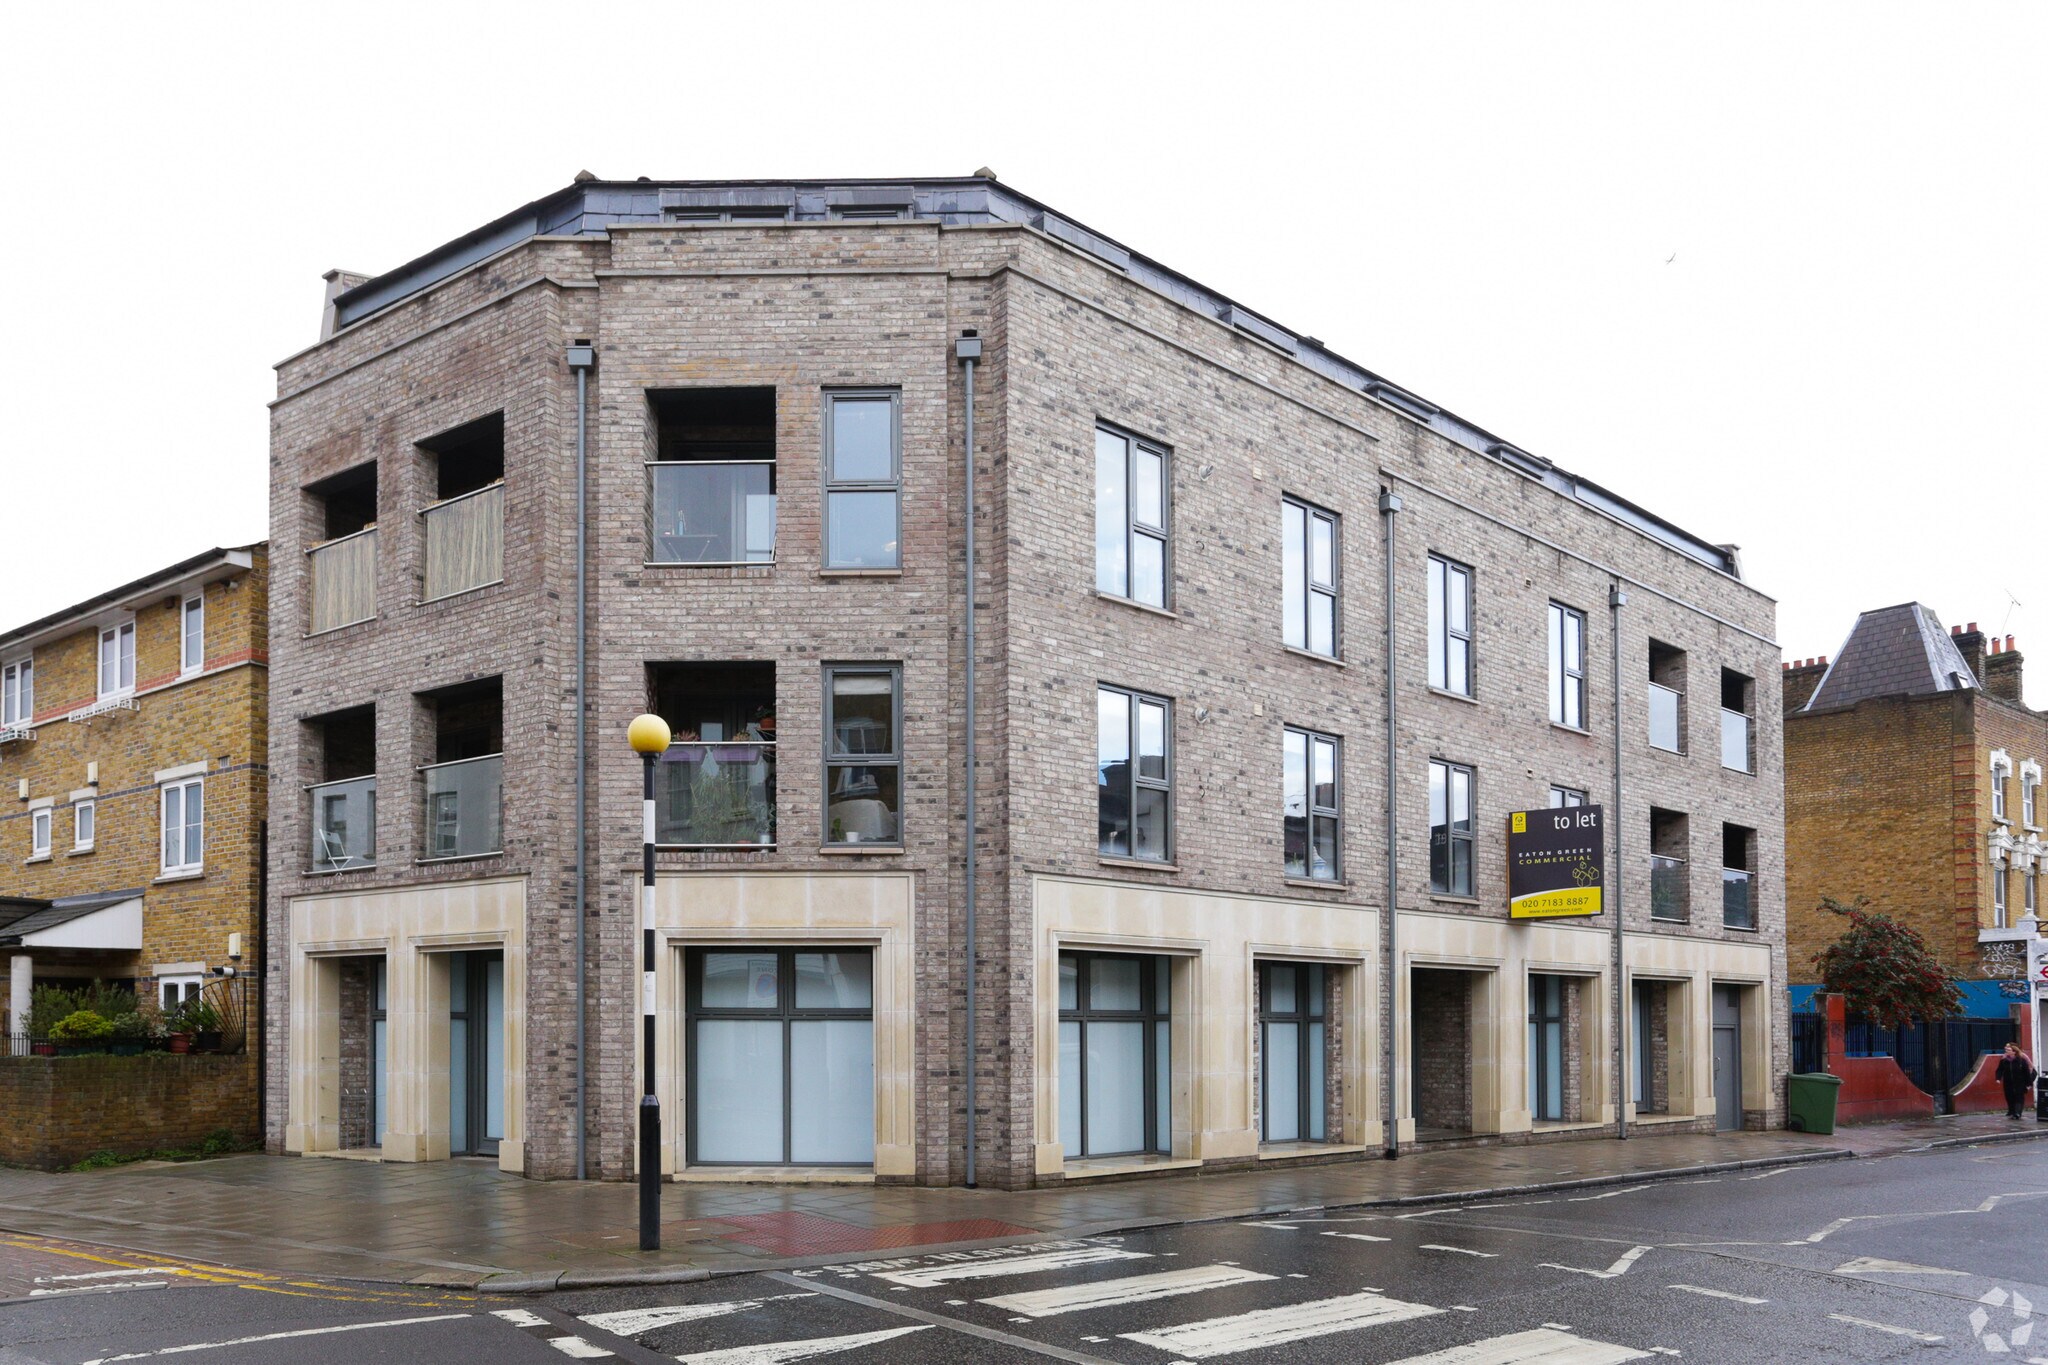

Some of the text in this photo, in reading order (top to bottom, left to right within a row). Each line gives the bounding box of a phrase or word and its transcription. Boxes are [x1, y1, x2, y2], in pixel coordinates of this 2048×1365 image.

[1554, 811, 1597, 830] to let
[1519, 848, 1592, 858] EATON GREEN
[1519, 855, 1592, 865] COMMERCIAL
[1522, 897, 1589, 908] 020 7183 8887
